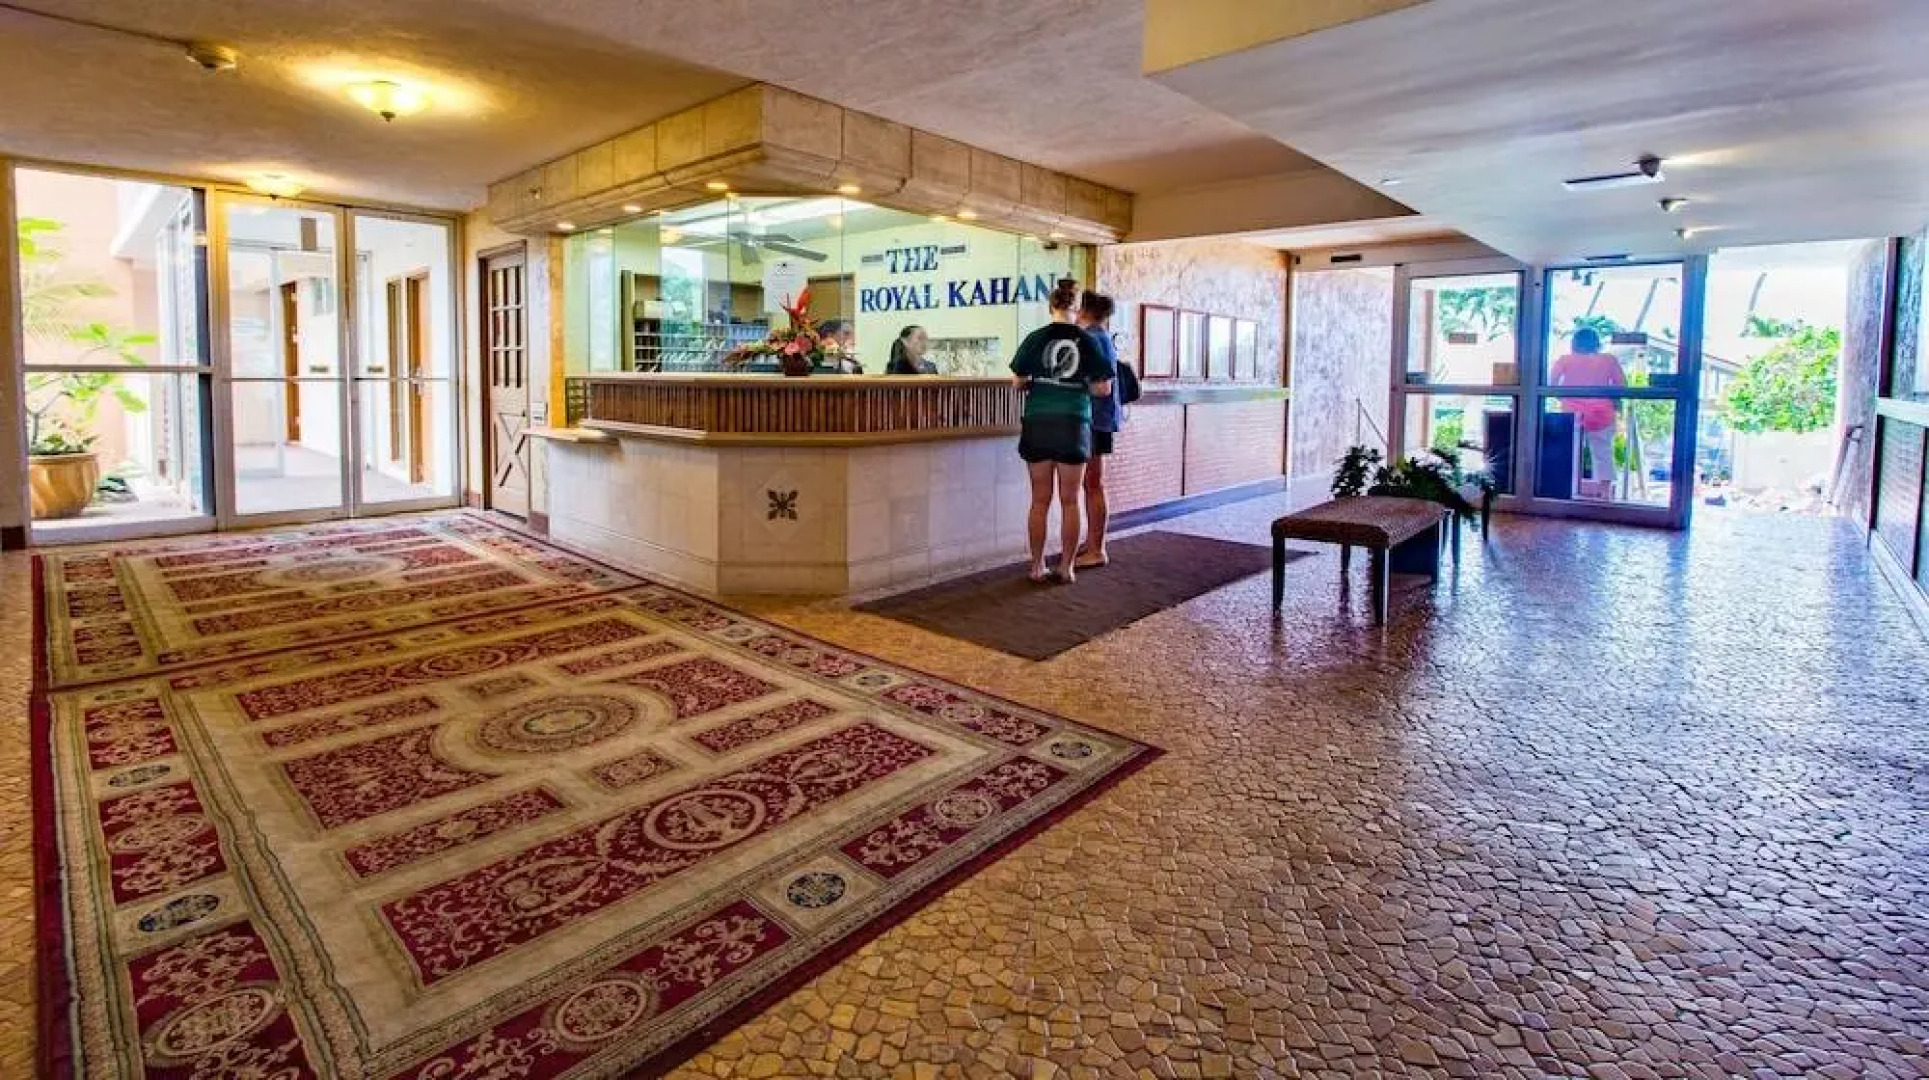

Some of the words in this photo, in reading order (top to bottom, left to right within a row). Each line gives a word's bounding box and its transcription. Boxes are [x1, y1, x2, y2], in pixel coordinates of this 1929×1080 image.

[886, 245, 938, 274] THE
[860, 283, 939, 313] ROYAL
[948, 272, 1071, 308] KAHAN
